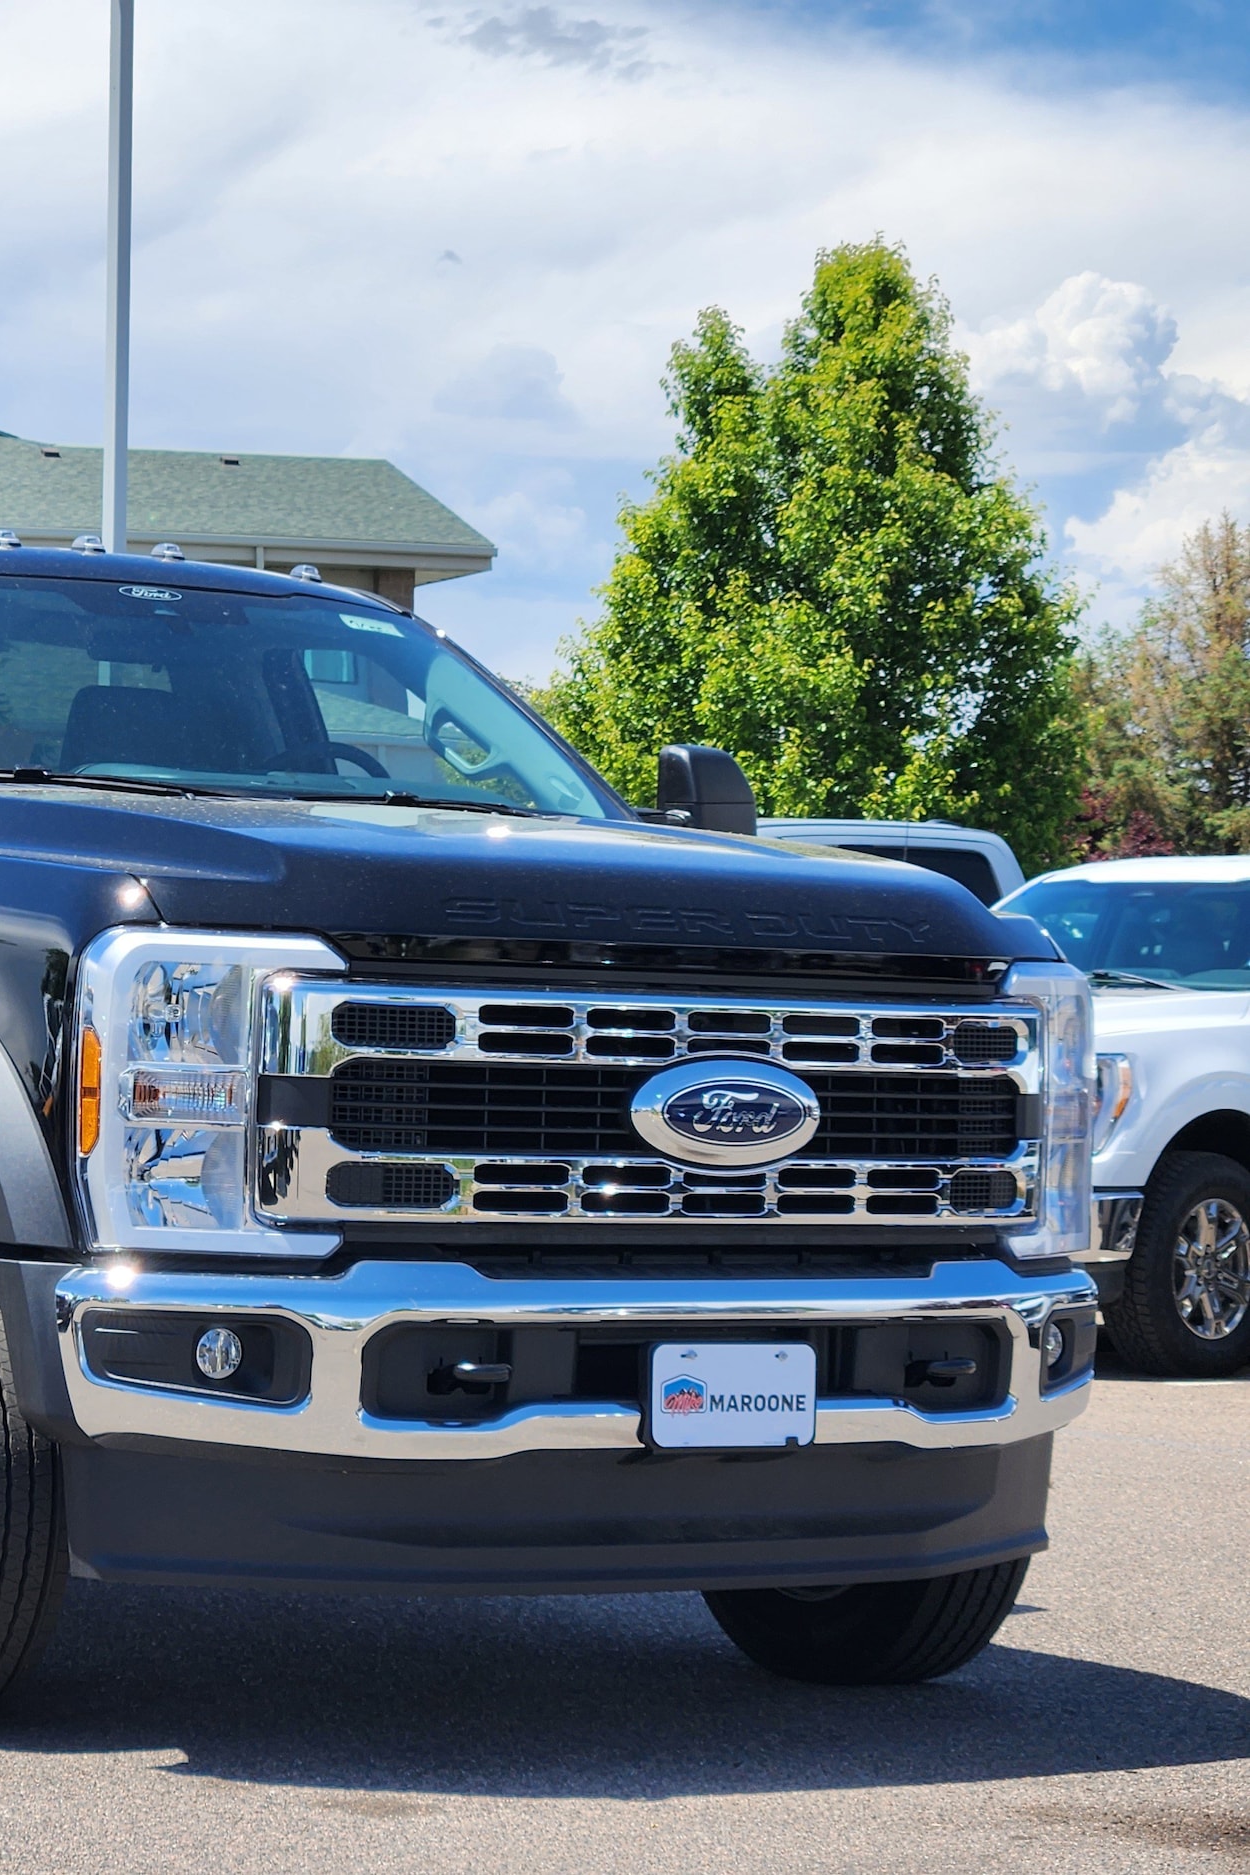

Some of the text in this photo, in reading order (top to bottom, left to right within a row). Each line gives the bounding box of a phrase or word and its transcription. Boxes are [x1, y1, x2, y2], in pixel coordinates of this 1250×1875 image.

[132, 587, 171, 599] Ford
[445, 900, 931, 943] SUPER DUTY
[693, 1089, 781, 1133] Ford
[709, 1394, 807, 1412] MAROONE
